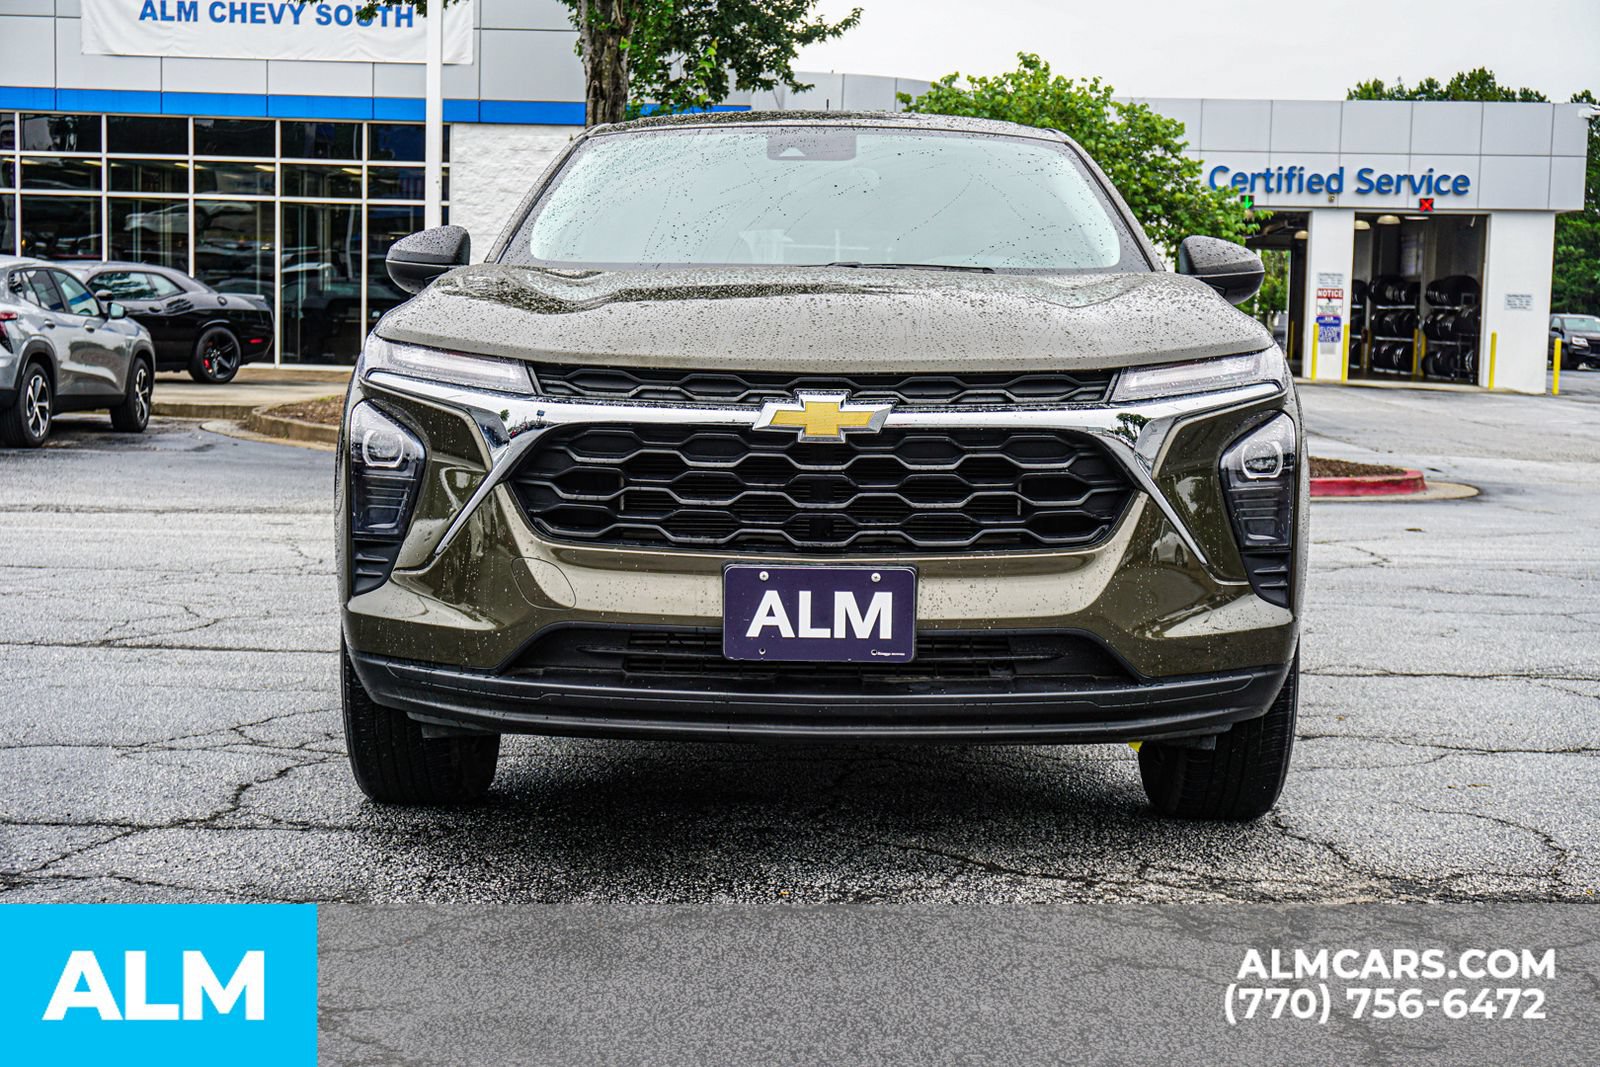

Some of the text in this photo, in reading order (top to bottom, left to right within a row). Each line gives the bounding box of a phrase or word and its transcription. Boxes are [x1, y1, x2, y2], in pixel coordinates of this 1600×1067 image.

[139, 0, 198, 22] ALM
[209, 1, 307, 25] CHEVY
[1209, 165, 1471, 196] Certified Service
[1317, 289, 1343, 297] NOTICE
[745, 590, 893, 640] ALM
